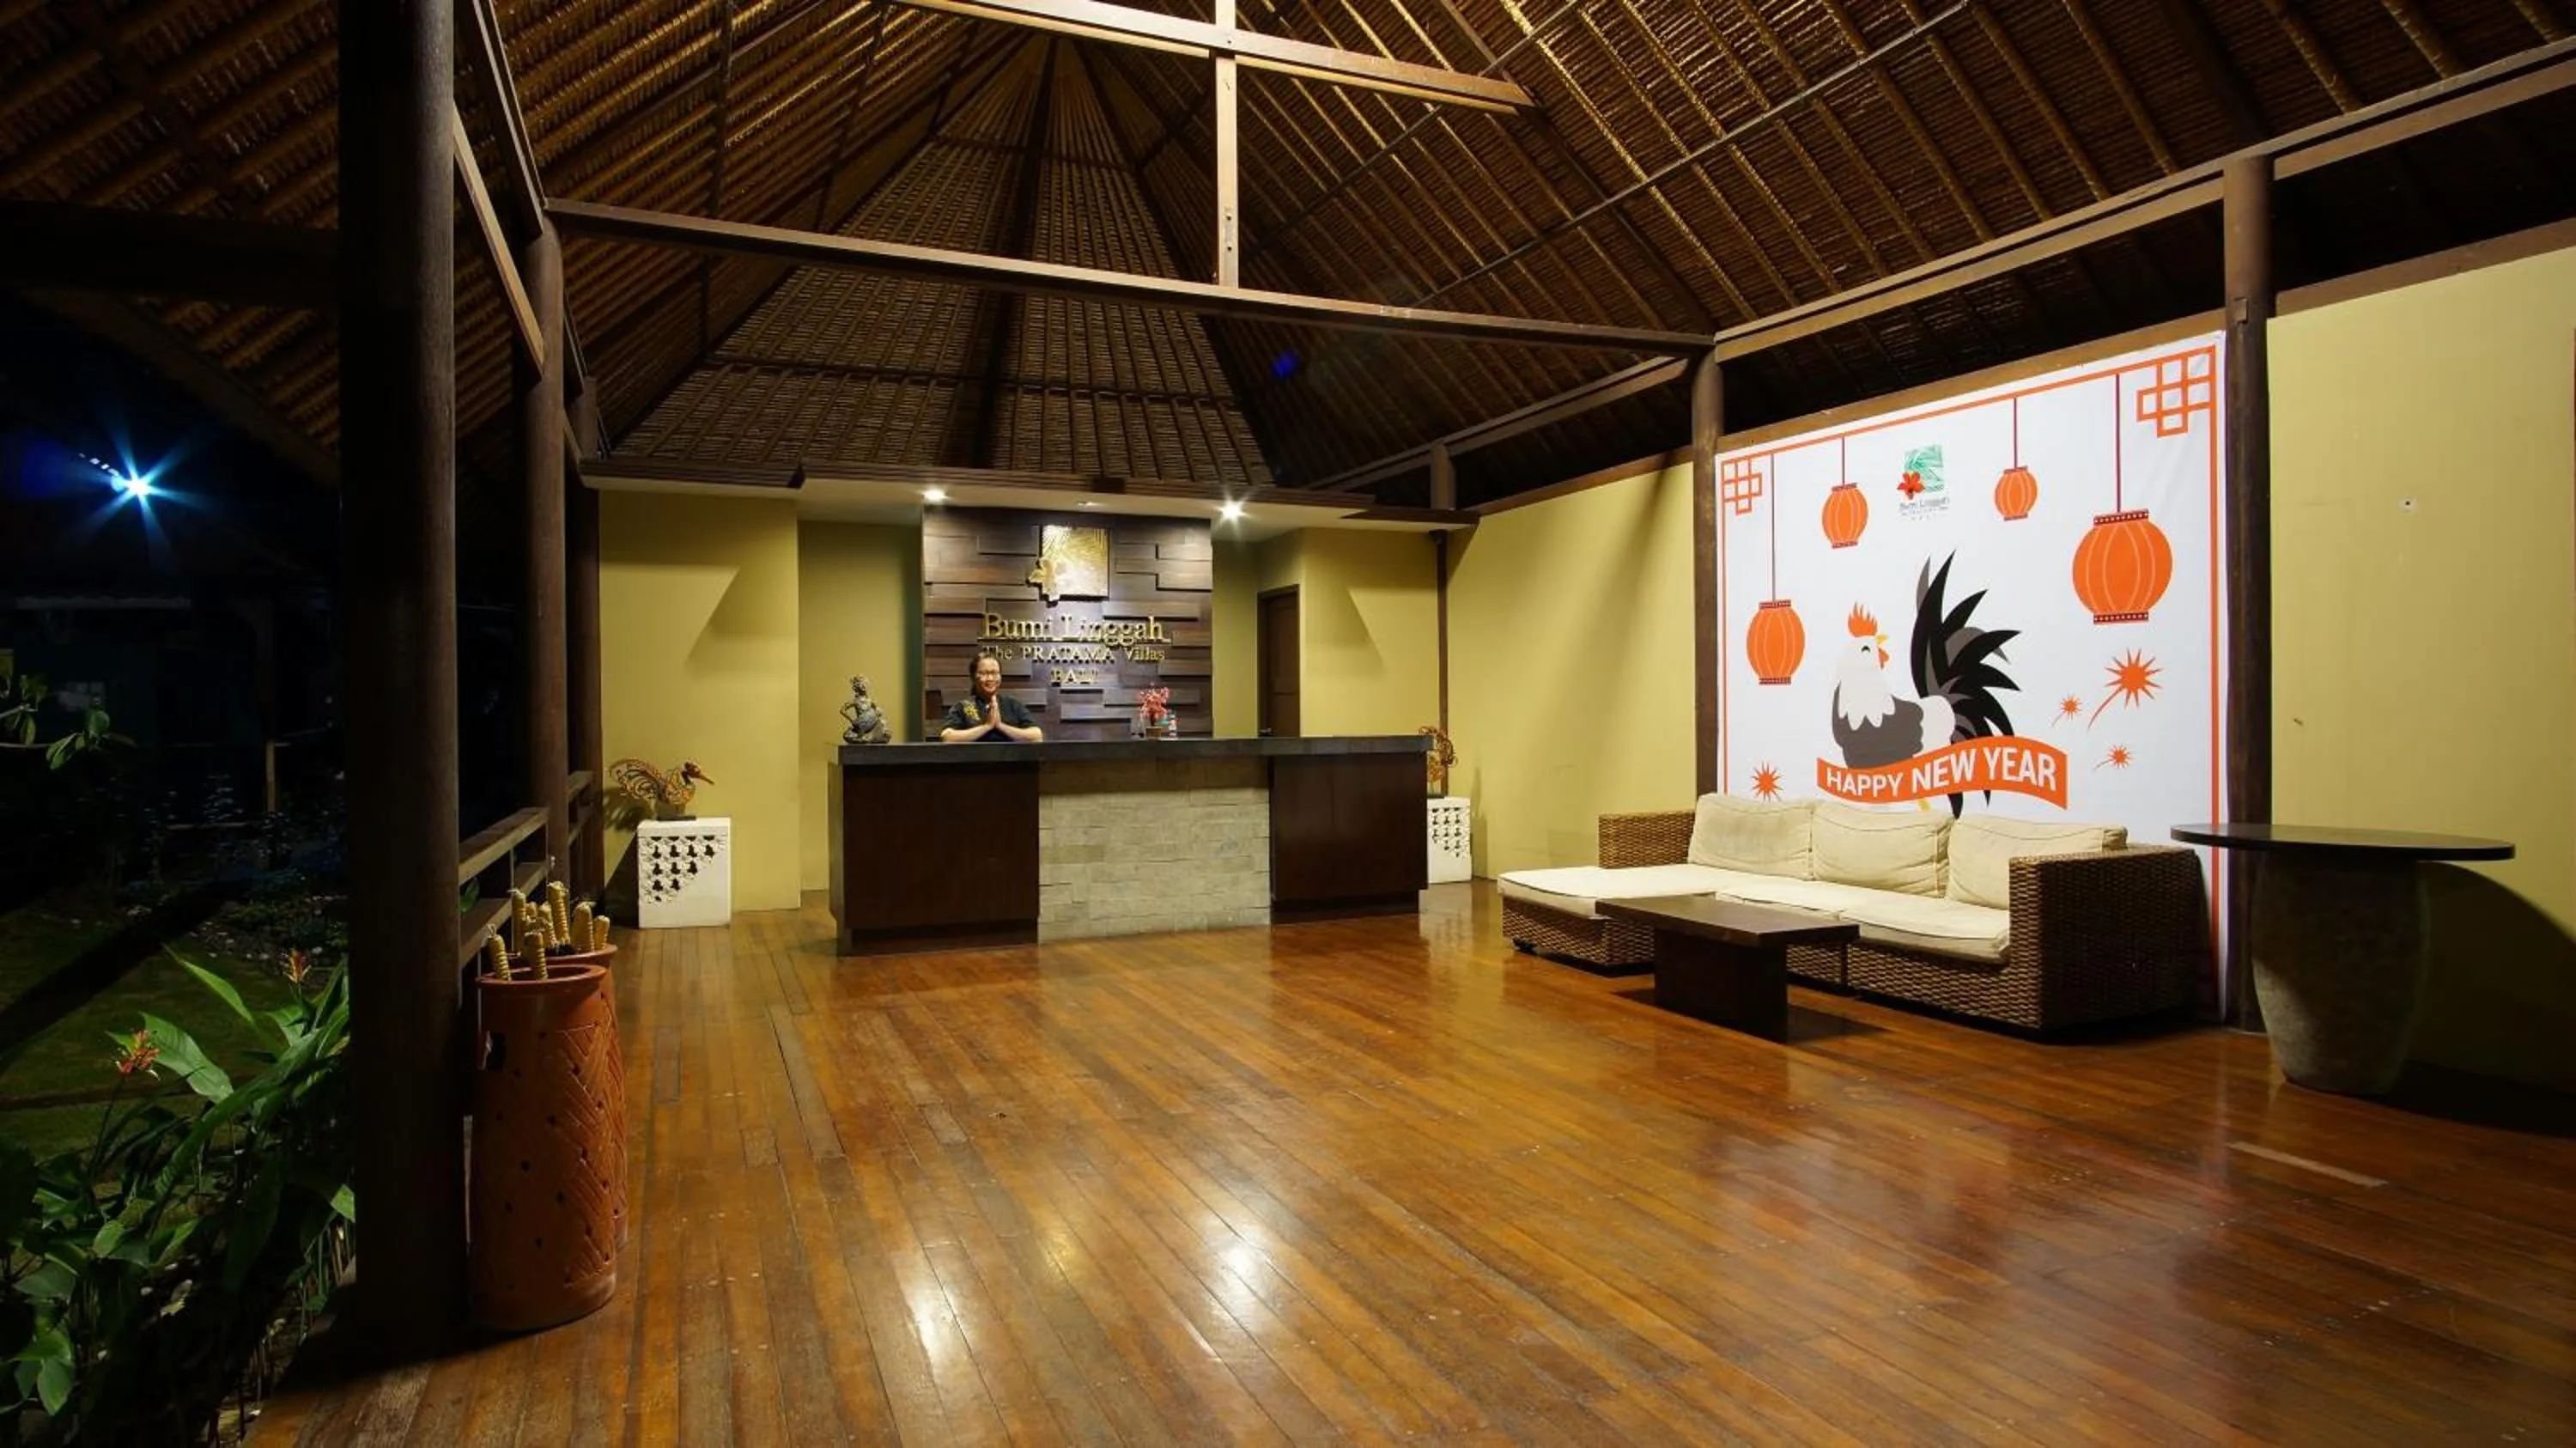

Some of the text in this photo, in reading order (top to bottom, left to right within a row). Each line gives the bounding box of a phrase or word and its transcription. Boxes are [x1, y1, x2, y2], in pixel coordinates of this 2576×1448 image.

[984, 612, 1165, 646] Bumi Linggah
[984, 646, 1166, 661] The PRATAMA Villas
[1826, 746, 2057, 798] HAPPY NEW YEAR
